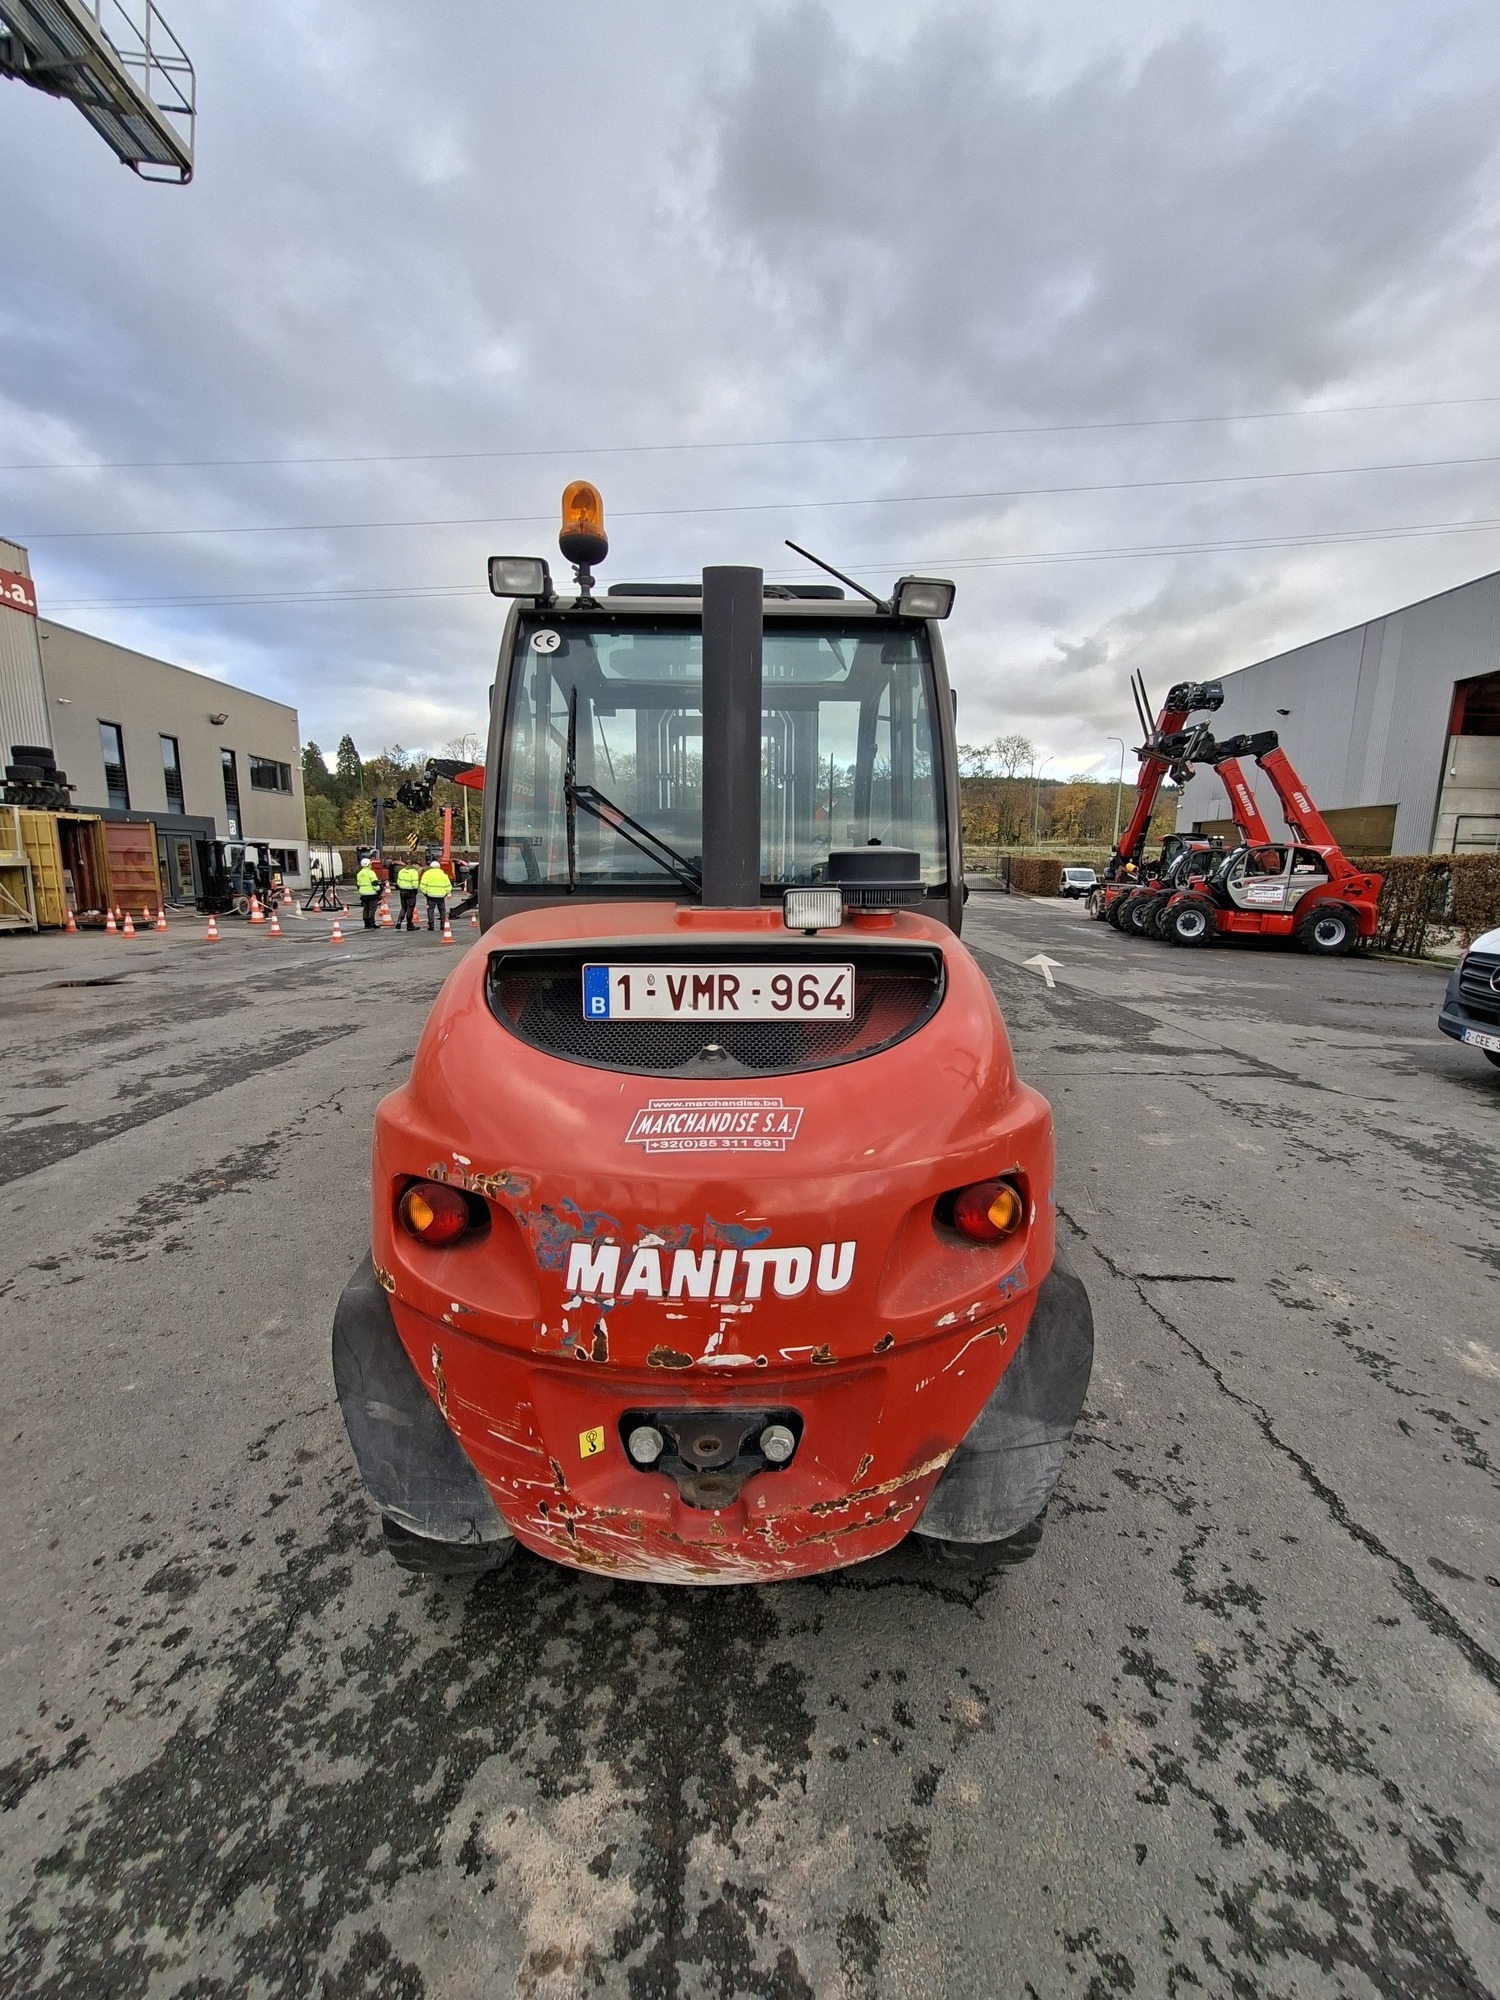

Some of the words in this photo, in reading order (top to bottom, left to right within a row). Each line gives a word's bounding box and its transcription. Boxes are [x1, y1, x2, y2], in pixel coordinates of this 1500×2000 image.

[0, 578, 34, 607] .a.
[533, 634, 556, 648] CE
[1235, 783, 1256, 817] MANITOU
[591, 996, 606, 1014] B
[617, 973, 846, 1011] 1-VMR-964
[652, 1099, 778, 1108] www.marchandise.be
[635, 1112, 760, 1135] MARCHANDISE
[761, 1112, 793, 1134] S.A.
[650, 1139, 718, 1149] +32(0)85
[721, 1139, 748, 1148] 311
[753, 1139, 780, 1148] 591
[566, 1240, 857, 1298] MANITOU
